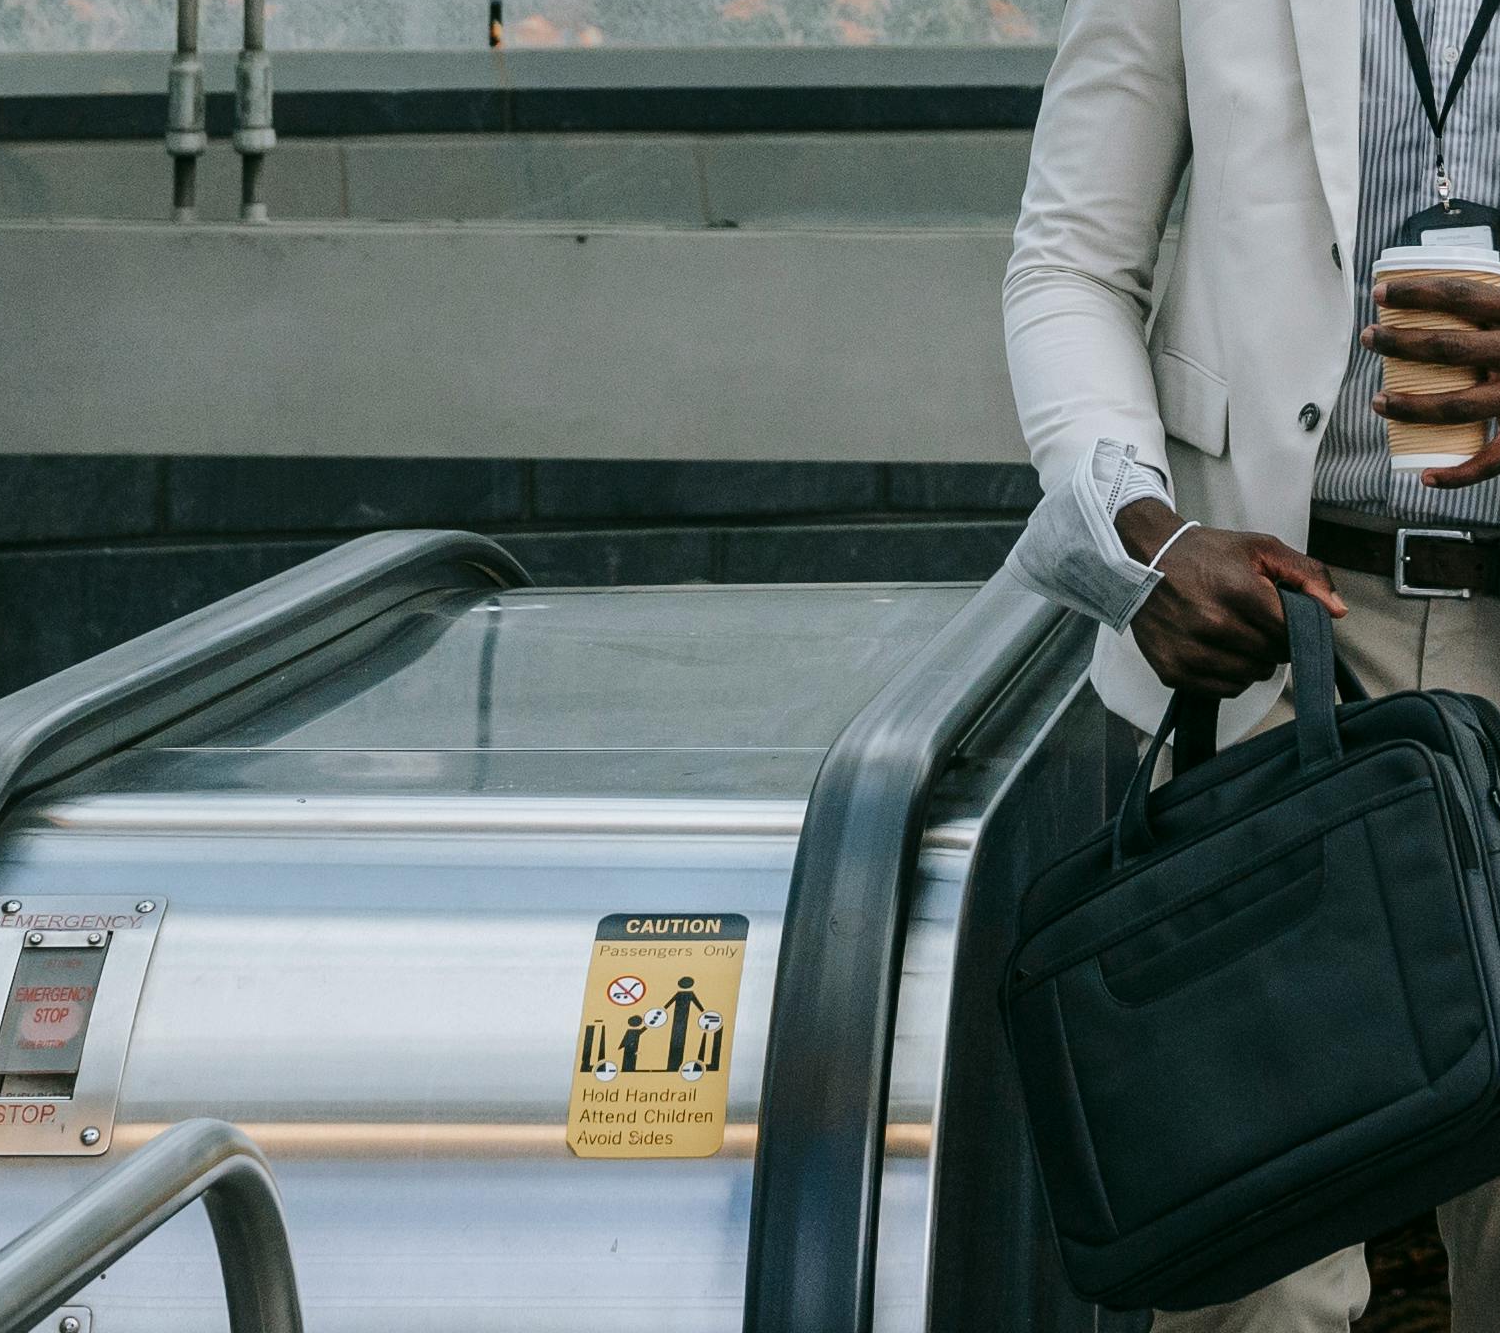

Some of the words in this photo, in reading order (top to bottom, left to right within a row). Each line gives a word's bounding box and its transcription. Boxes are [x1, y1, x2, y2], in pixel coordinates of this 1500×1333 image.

[0, 914, 143, 929] EMERGENCY
[626, 919, 721, 934] CAUTION
[599, 945, 693, 959] Passengers
[703, 945, 739, 958] Only
[15, 986, 93, 1002] EMERGENCY
[33, 1007, 69, 1023] STOP
[582, 1088, 619, 1102] Hold
[625, 1088, 697, 1102] Handrail
[579, 1109, 637, 1123] Attend
[644, 1109, 713, 1123] Children
[576, 1130, 622, 1145] Avoid
[628, 1130, 673, 1145] Sides
